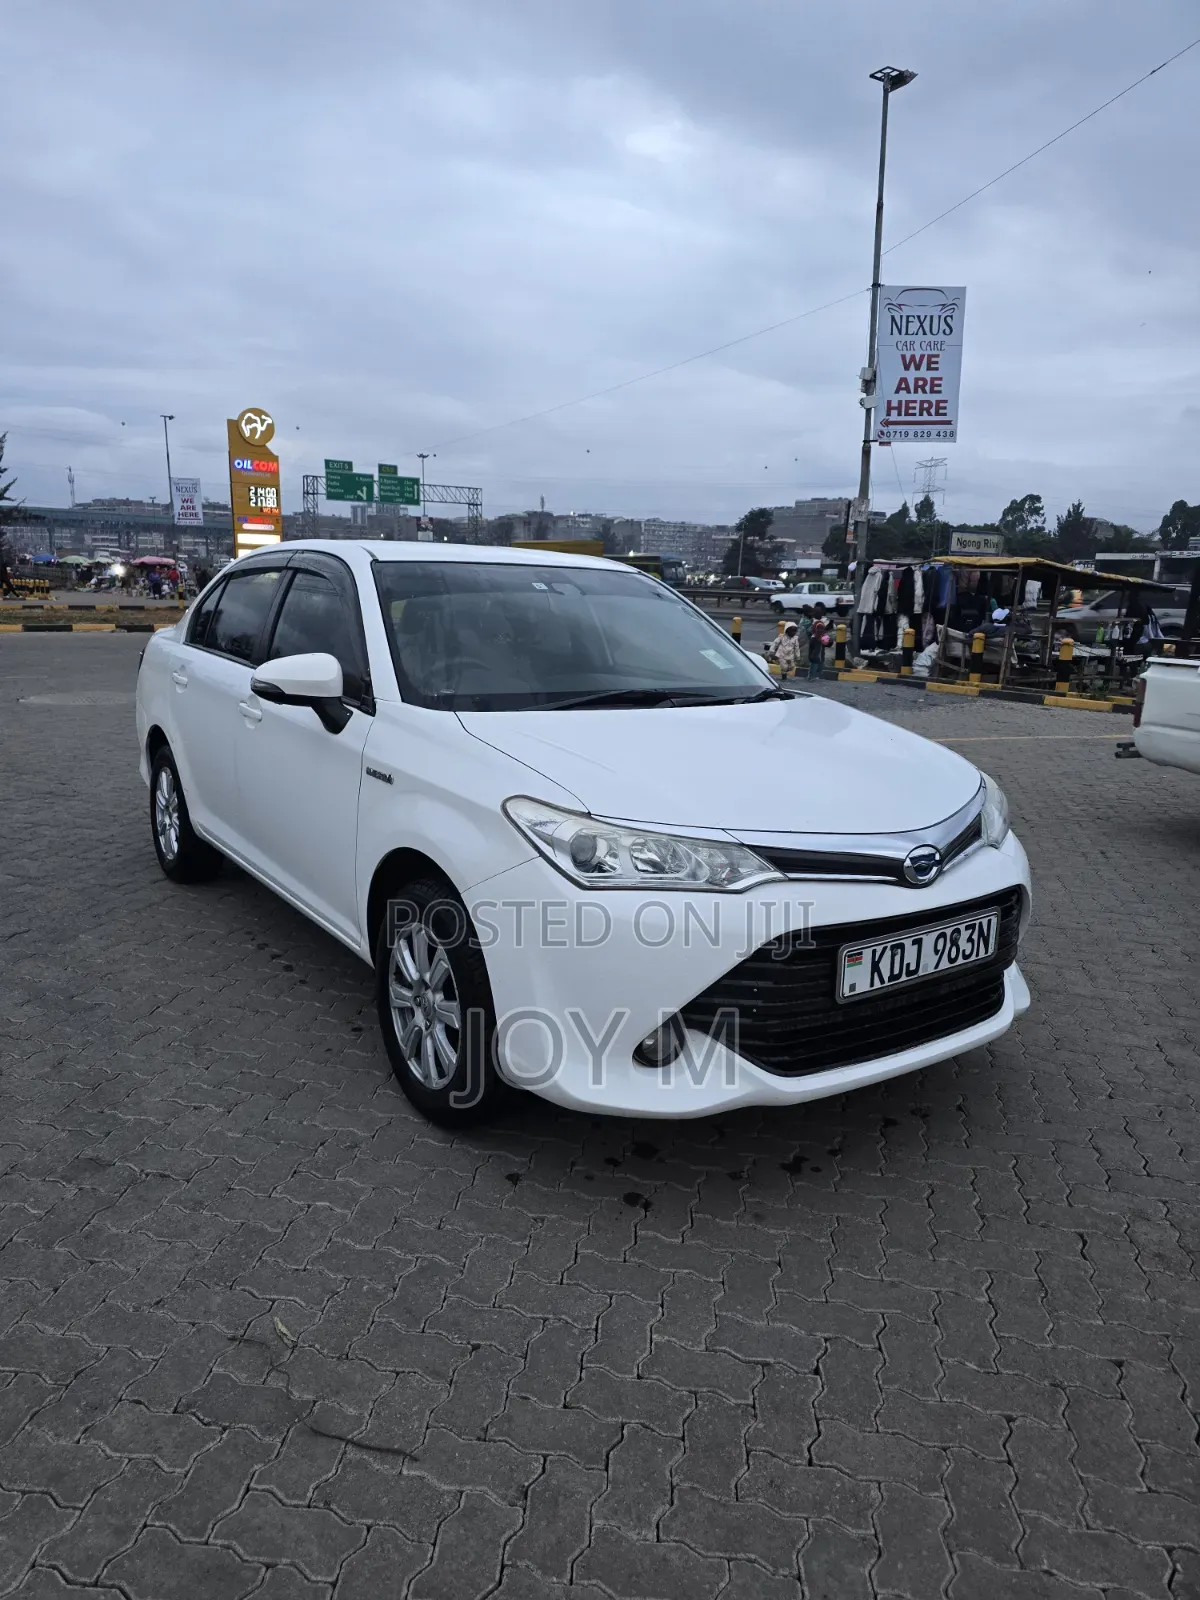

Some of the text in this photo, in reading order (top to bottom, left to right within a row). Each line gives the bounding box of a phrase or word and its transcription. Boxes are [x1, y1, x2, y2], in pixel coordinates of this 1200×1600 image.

[890, 314, 954, 336] NEXUS
[895, 340, 946, 352] CAR CARE
[900, 353, 941, 372] WE
[894, 376, 943, 395] ARE
[885, 399, 949, 417] HERE
[885, 430, 955, 439] 0719 829 438
[234, 459, 278, 472] OILCOM
[329, 461, 344, 469] EXIT
[175, 485, 198, 494] NEXUS
[956, 536, 981, 550] Ngong
[869, 918, 993, 988] KDJ 983N
